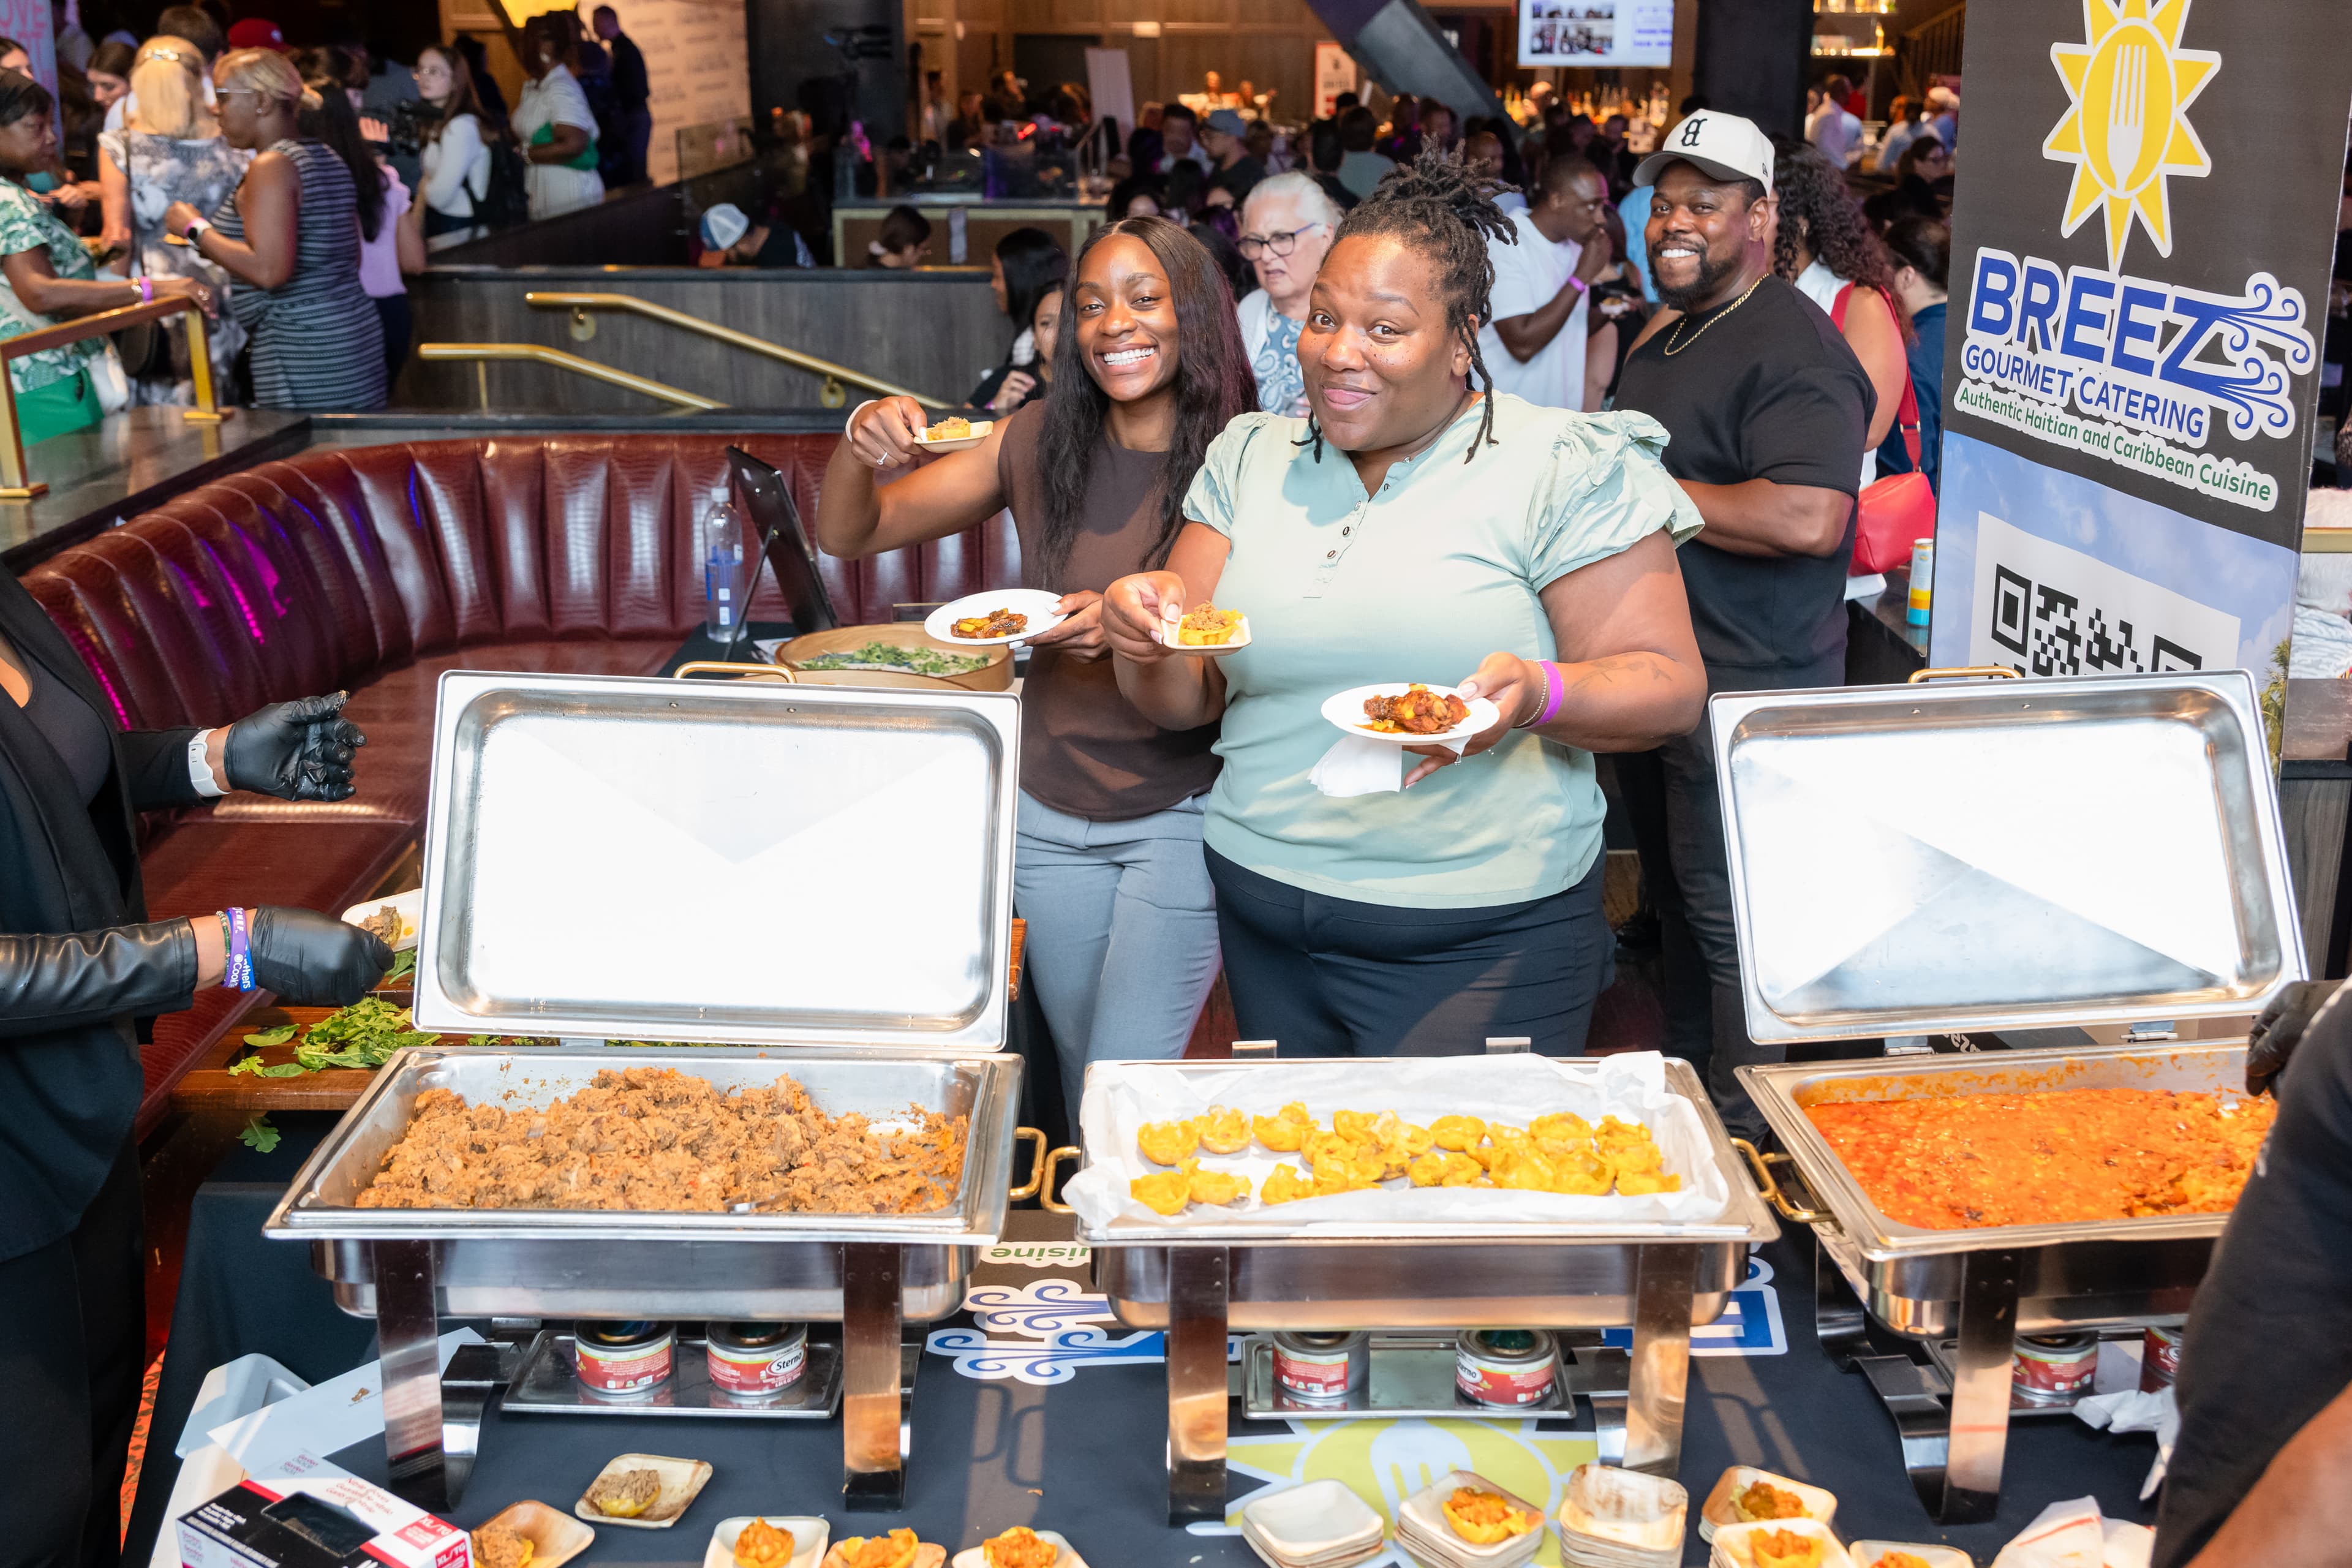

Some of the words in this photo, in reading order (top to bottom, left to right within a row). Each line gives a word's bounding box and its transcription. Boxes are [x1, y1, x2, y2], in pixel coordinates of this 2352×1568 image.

[1970, 256, 2310, 429] BREEZ
[1966, 344, 2073, 398] GOURMET
[2079, 376, 2204, 438] CATERING
[1959, 387, 2022, 421] Authentic
[2025, 407, 2078, 440] Haitian
[2082, 429, 2110, 450] and
[2114, 435, 2194, 479] Caribbean
[2199, 464, 2271, 501] Cuisine
[776, 1351, 802, 1371] Sterno
[419, 1517, 453, 1536] XL/TG
[437, 1542, 466, 1567] XL/TG
